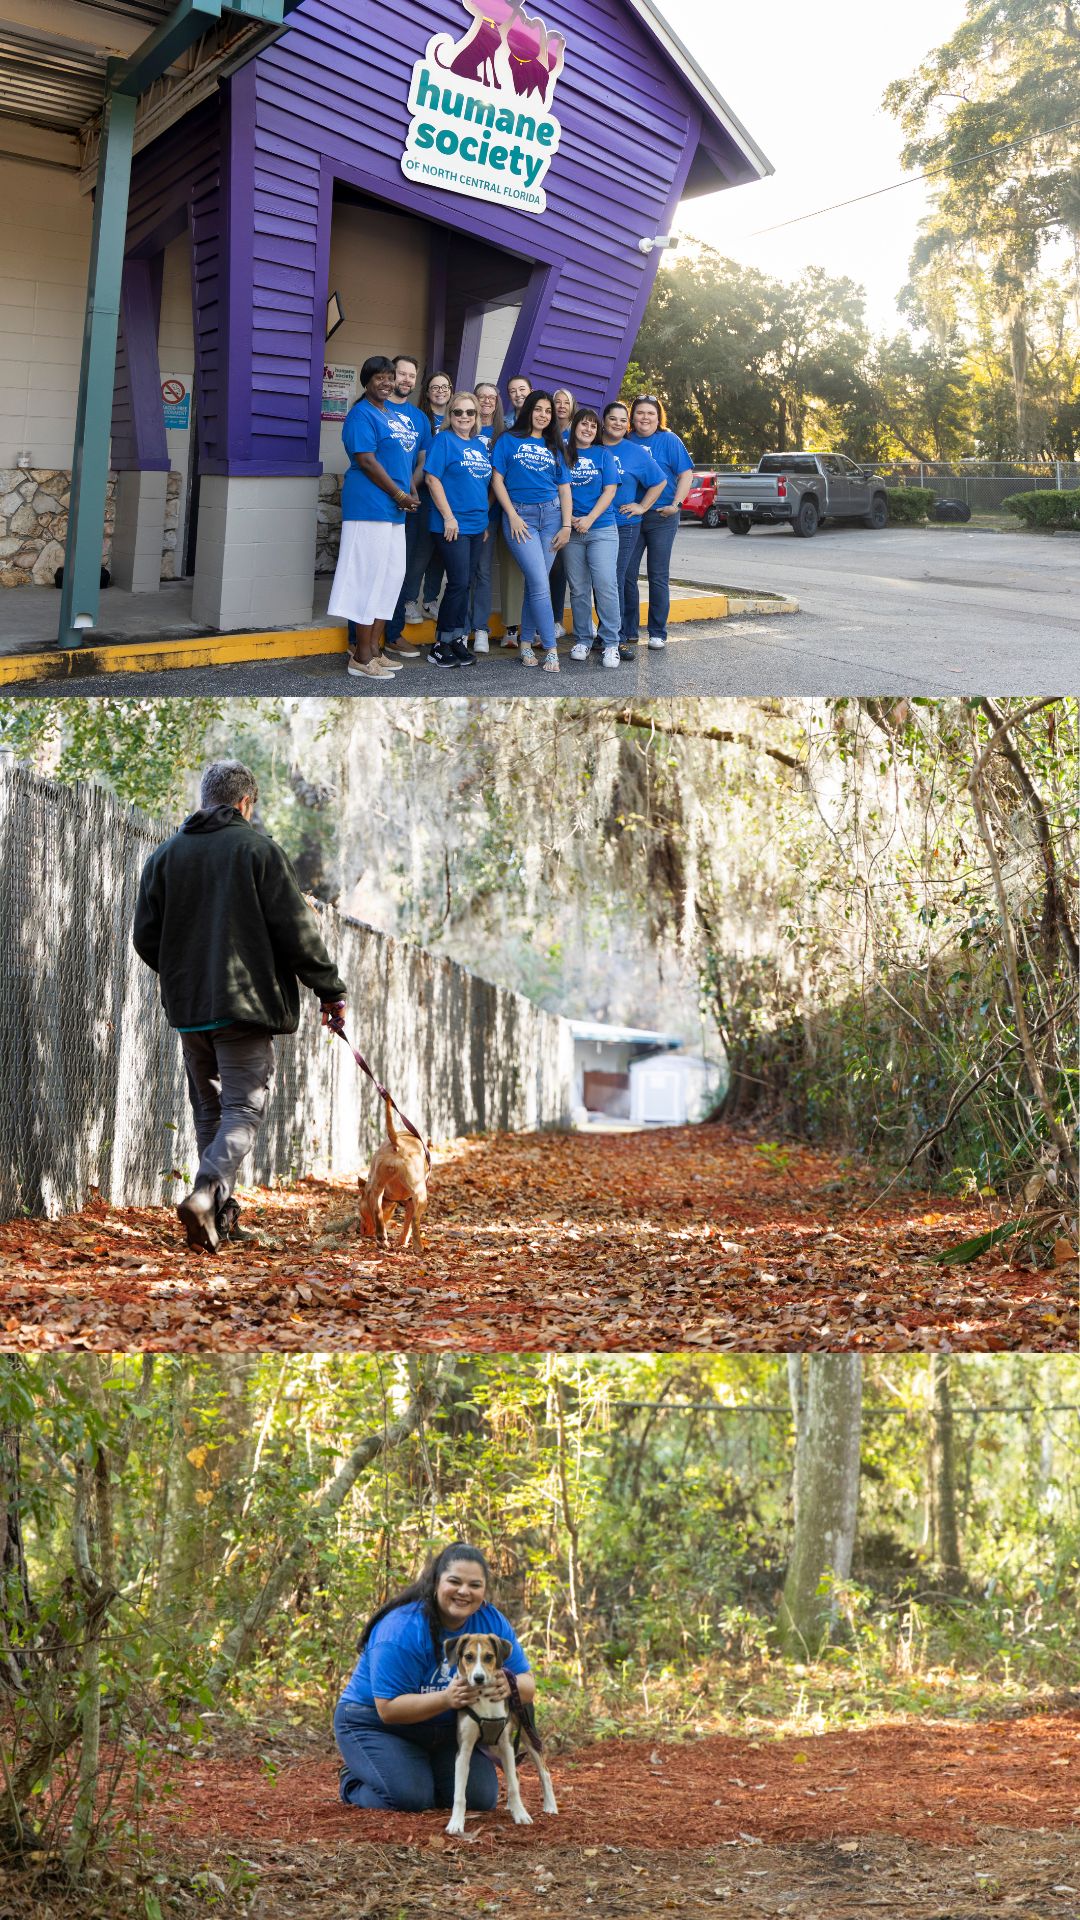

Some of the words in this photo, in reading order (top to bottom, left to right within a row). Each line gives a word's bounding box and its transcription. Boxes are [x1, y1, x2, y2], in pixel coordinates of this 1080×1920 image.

[415, 68, 555, 146] humane
[405, 159, 421, 171] OF
[422, 164, 458, 182] NORTH
[459, 174, 502, 194] CENTRAL
[503, 186, 541, 205] FLORIDA
[414, 122, 544, 188] society
[513, 452, 540, 461] HELPING
